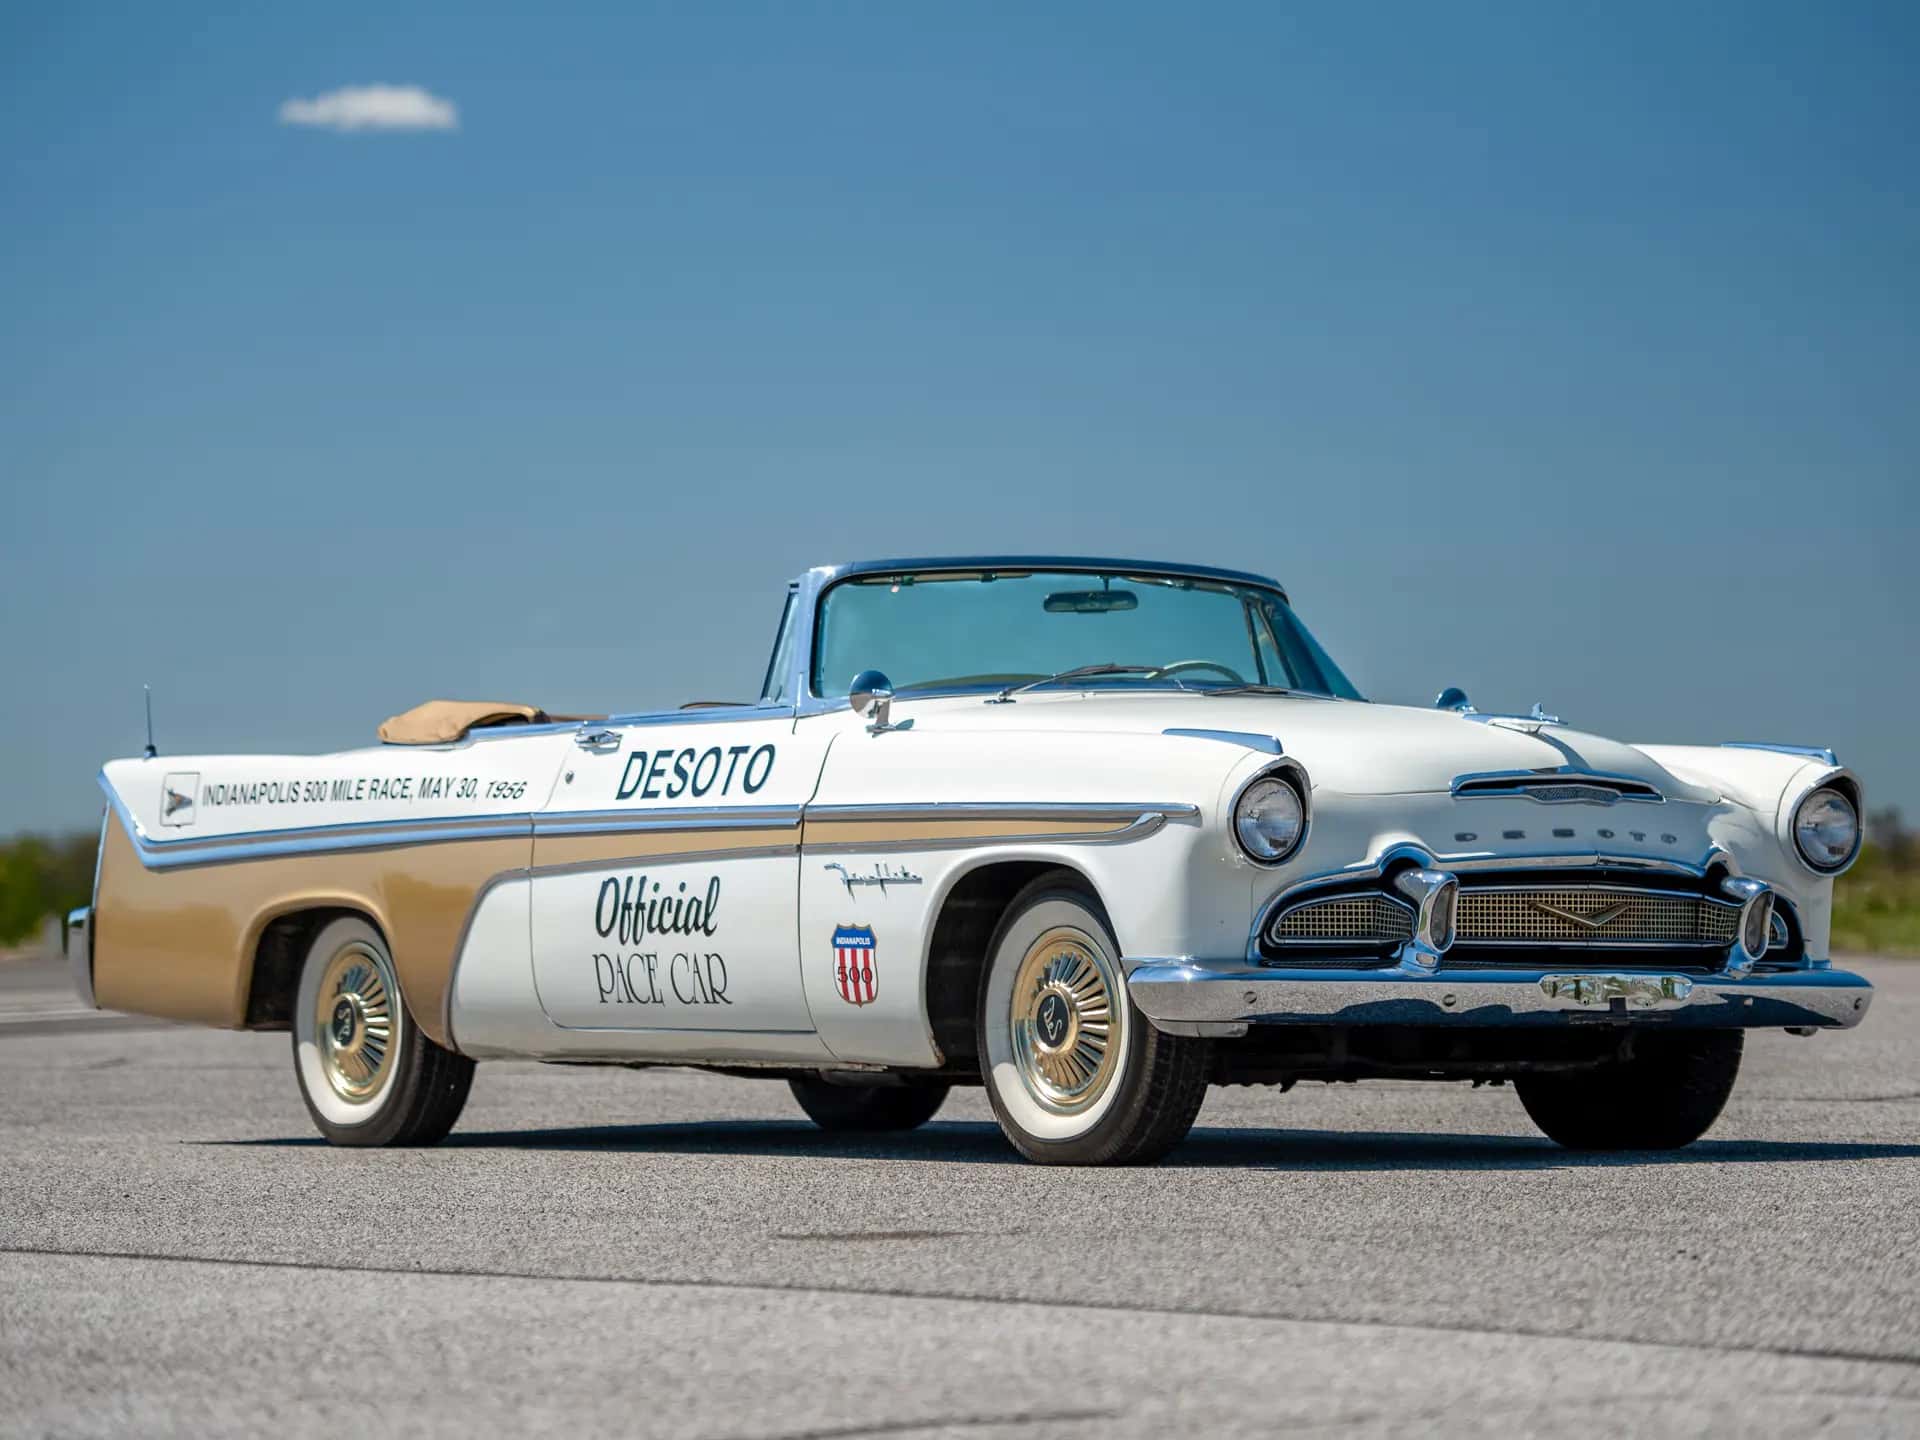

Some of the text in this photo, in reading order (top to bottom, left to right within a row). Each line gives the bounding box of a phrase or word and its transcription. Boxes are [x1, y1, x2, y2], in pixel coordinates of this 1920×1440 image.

[202, 776, 528, 806] INDIANAPOLIS 500 MILE RACE, MAY 30, 1956
[615, 743, 776, 800] DESOTO
[594, 875, 721, 946] Official
[836, 936, 871, 945] INDIANAPOLIS
[591, 951, 733, 1006] PACE CAR
[837, 965, 873, 984] 500
